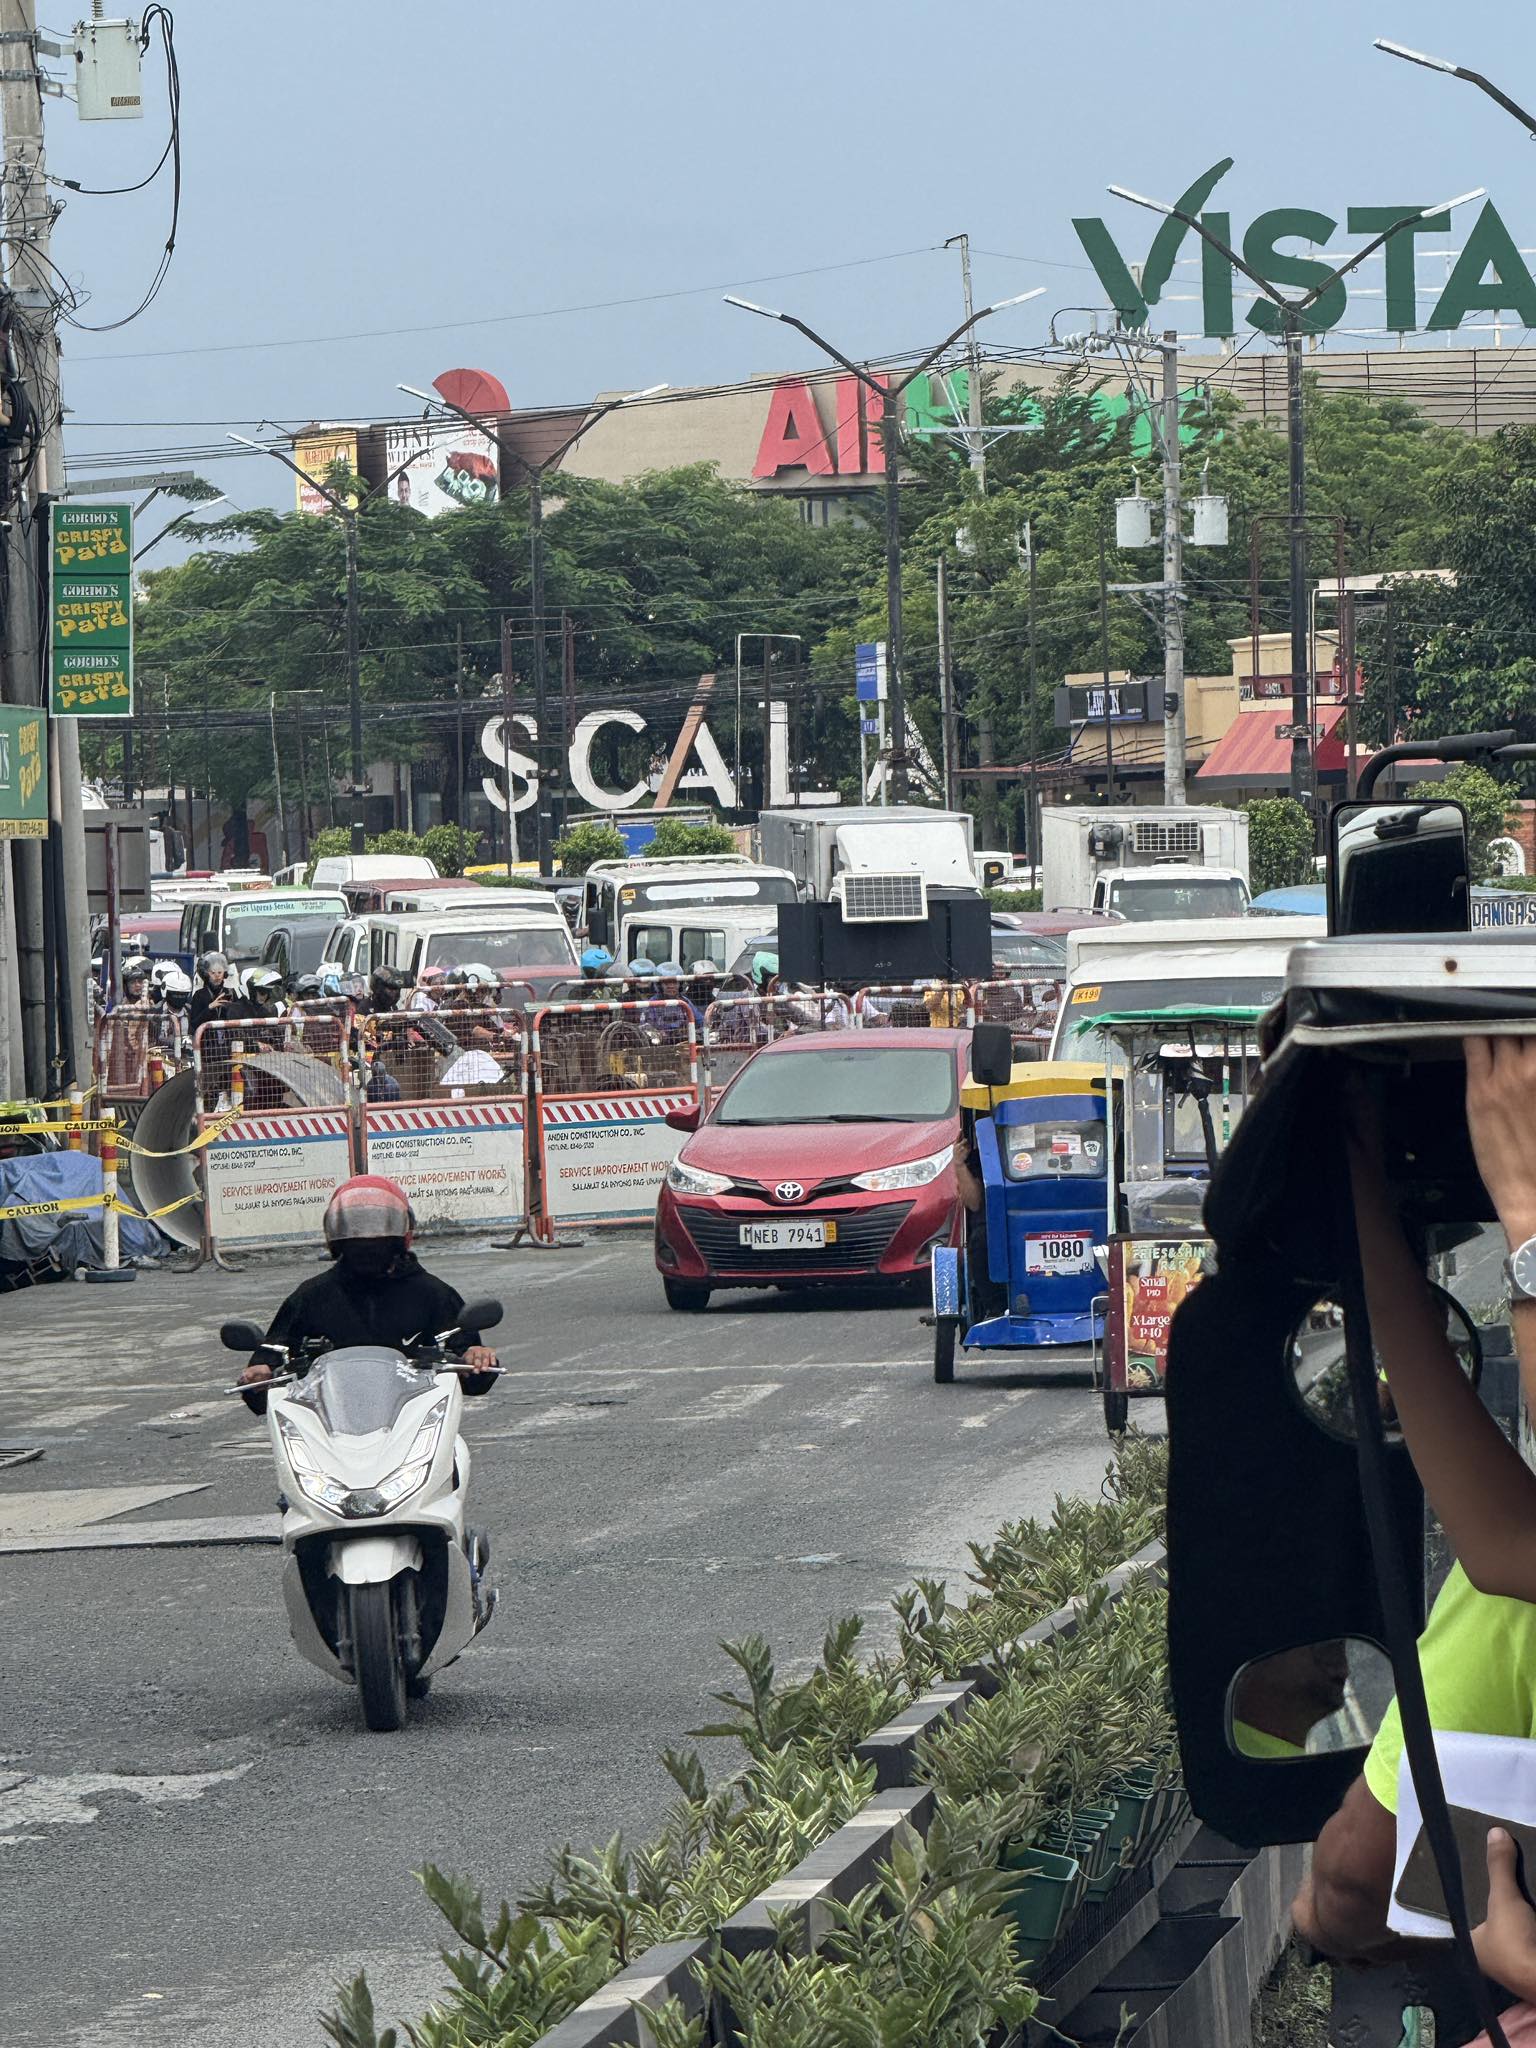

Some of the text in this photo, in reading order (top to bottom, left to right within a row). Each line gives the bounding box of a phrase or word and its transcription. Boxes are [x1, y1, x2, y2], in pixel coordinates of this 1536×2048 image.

[1071, 156, 1536, 338] VISTA
[56, 527, 123, 543] CRISPY
[57, 600, 123, 616] CRISPY
[58, 671, 124, 687] CRISPY
[570, 1129, 619, 1140] CONSTRUCTION
[395, 1137, 445, 1149] CONSTRUCTION
[231, 1148, 279, 1160] CONSTRUCTION
[418, 1171, 476, 1184] IMPROVEMENT
[478, 1169, 507, 1180] WORKS
[560, 1168, 592, 1178] SERVICE
[593, 1163, 648, 1175] IMPROVEMENT
[222, 1177, 336, 1198] SERVICE IMPROVEMENT WORKS
[6, 1202, 59, 1218] CAUTION
[754, 1229, 778, 1244] NEB
[788, 1227, 823, 1243] 7941
[1039, 1240, 1084, 1259] 1080
[1140, 1277, 1167, 1288] Small
